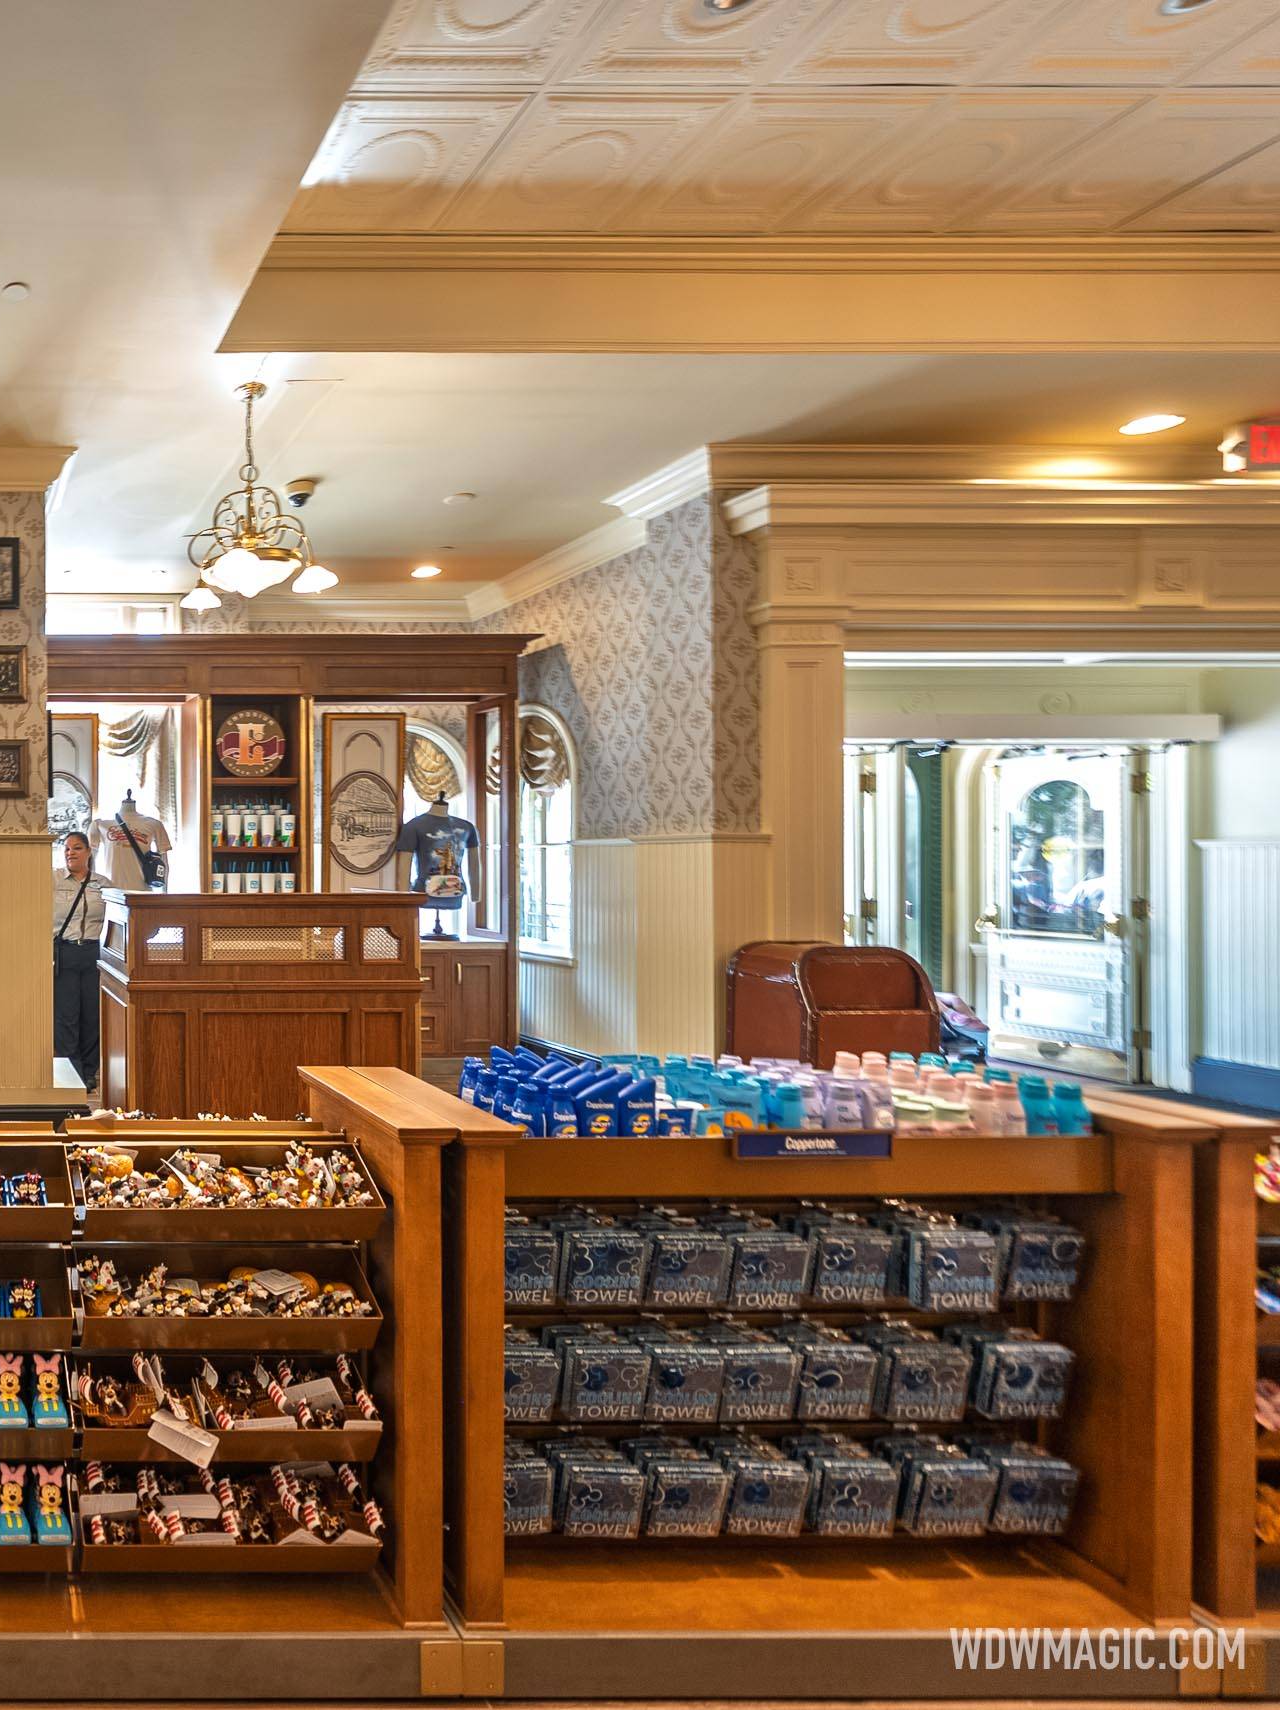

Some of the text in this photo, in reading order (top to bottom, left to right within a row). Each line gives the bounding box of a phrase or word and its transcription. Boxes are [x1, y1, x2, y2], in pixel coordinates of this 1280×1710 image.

[785, 1135, 838, 1152] Coppertone
[504, 1289, 551, 1303] OWEL
[574, 1289, 638, 1304] TOWEL
[653, 1290, 714, 1304] TOWEL
[736, 1293, 798, 1308] TOWEL
[821, 1285, 885, 1302] TOWEL
[930, 1292, 995, 1311] TOWEL
[577, 1405, 639, 1418] TOWEL
[653, 1405, 714, 1419] TOWEL
[727, 1404, 788, 1419] TOWEL
[806, 1403, 866, 1417] TOWEL
[896, 1404, 961, 1419] TOWEL
[571, 1522, 637, 1536] TOWEL
[655, 1521, 715, 1536] TOWEL
[824, 1520, 890, 1536] TOWEL
[923, 1520, 982, 1534] TOWEL
